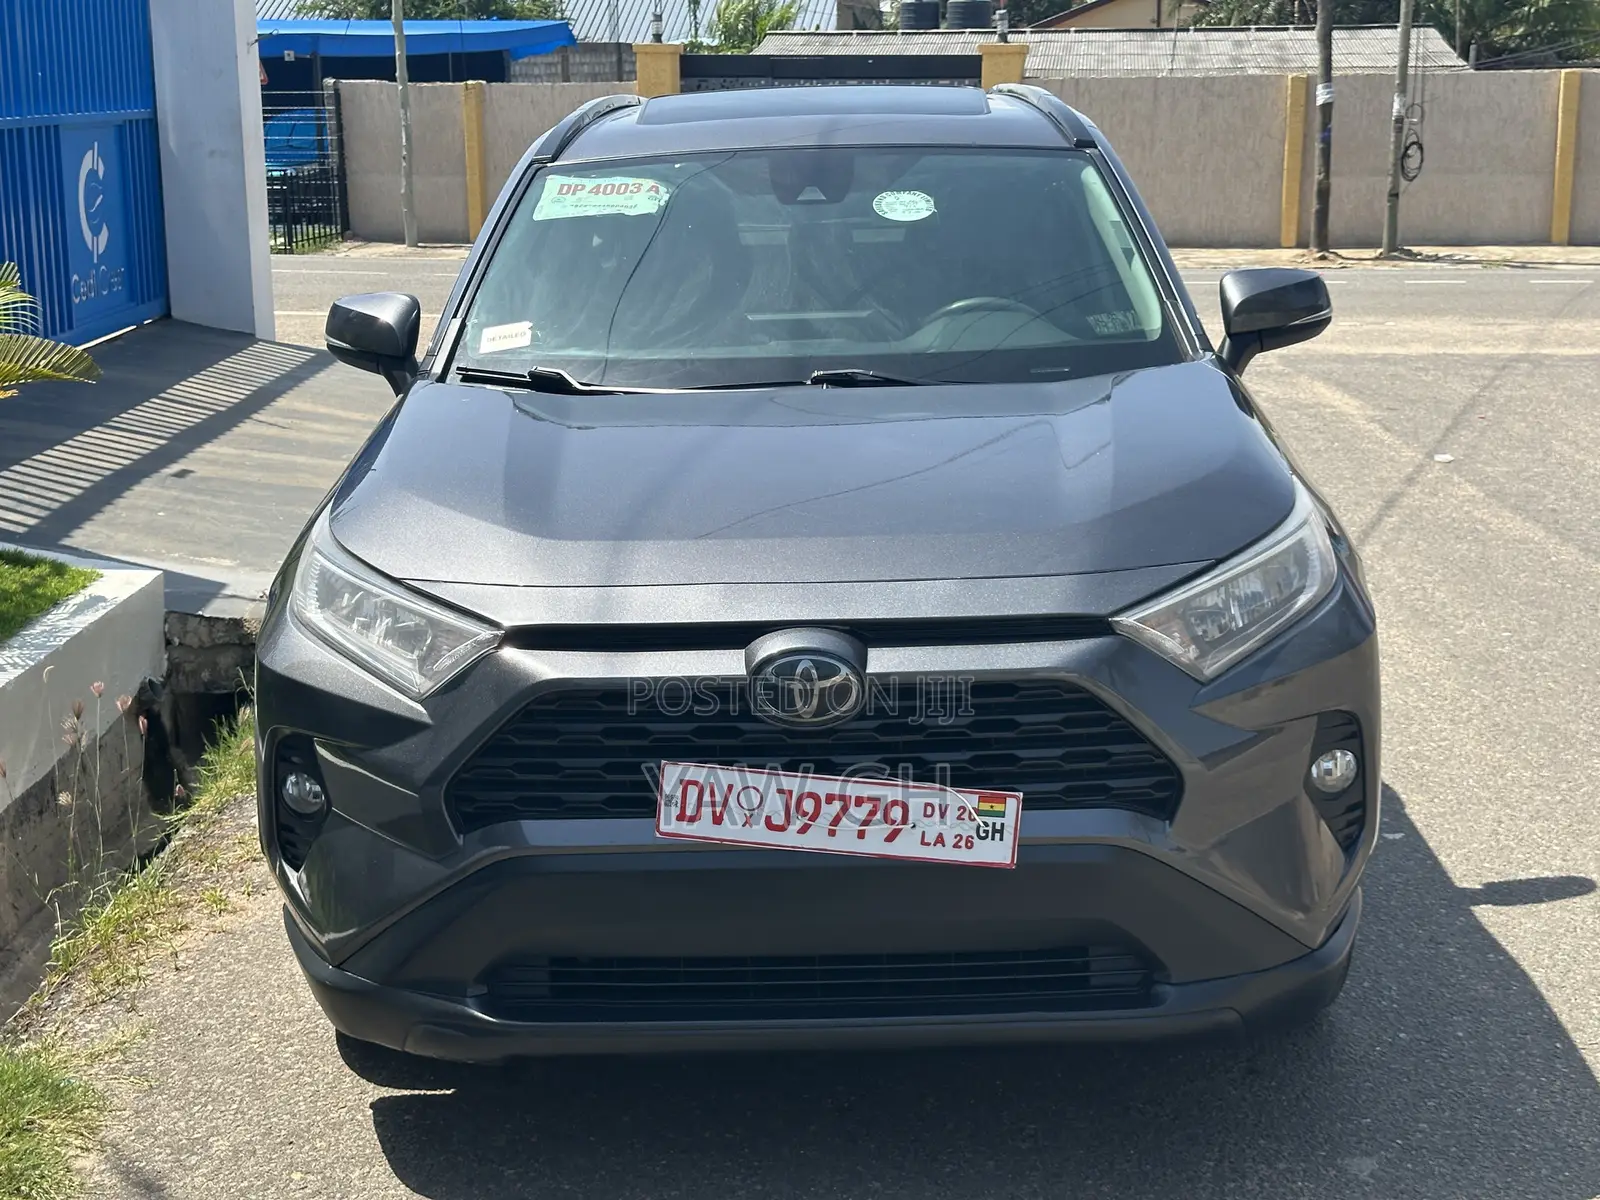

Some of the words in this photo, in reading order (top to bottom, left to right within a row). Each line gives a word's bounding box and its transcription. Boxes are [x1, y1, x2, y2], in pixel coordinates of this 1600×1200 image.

[557, 183, 586, 196] DP
[587, 183, 643, 196] 4003
[647, 182, 660, 195] A
[676, 779, 734, 825] DV
[764, 788, 910, 843] J9779
[923, 802, 949, 819] DV
[920, 830, 946, 847] LA
[952, 833, 975, 850] 26
[976, 821, 1005, 841] GH
